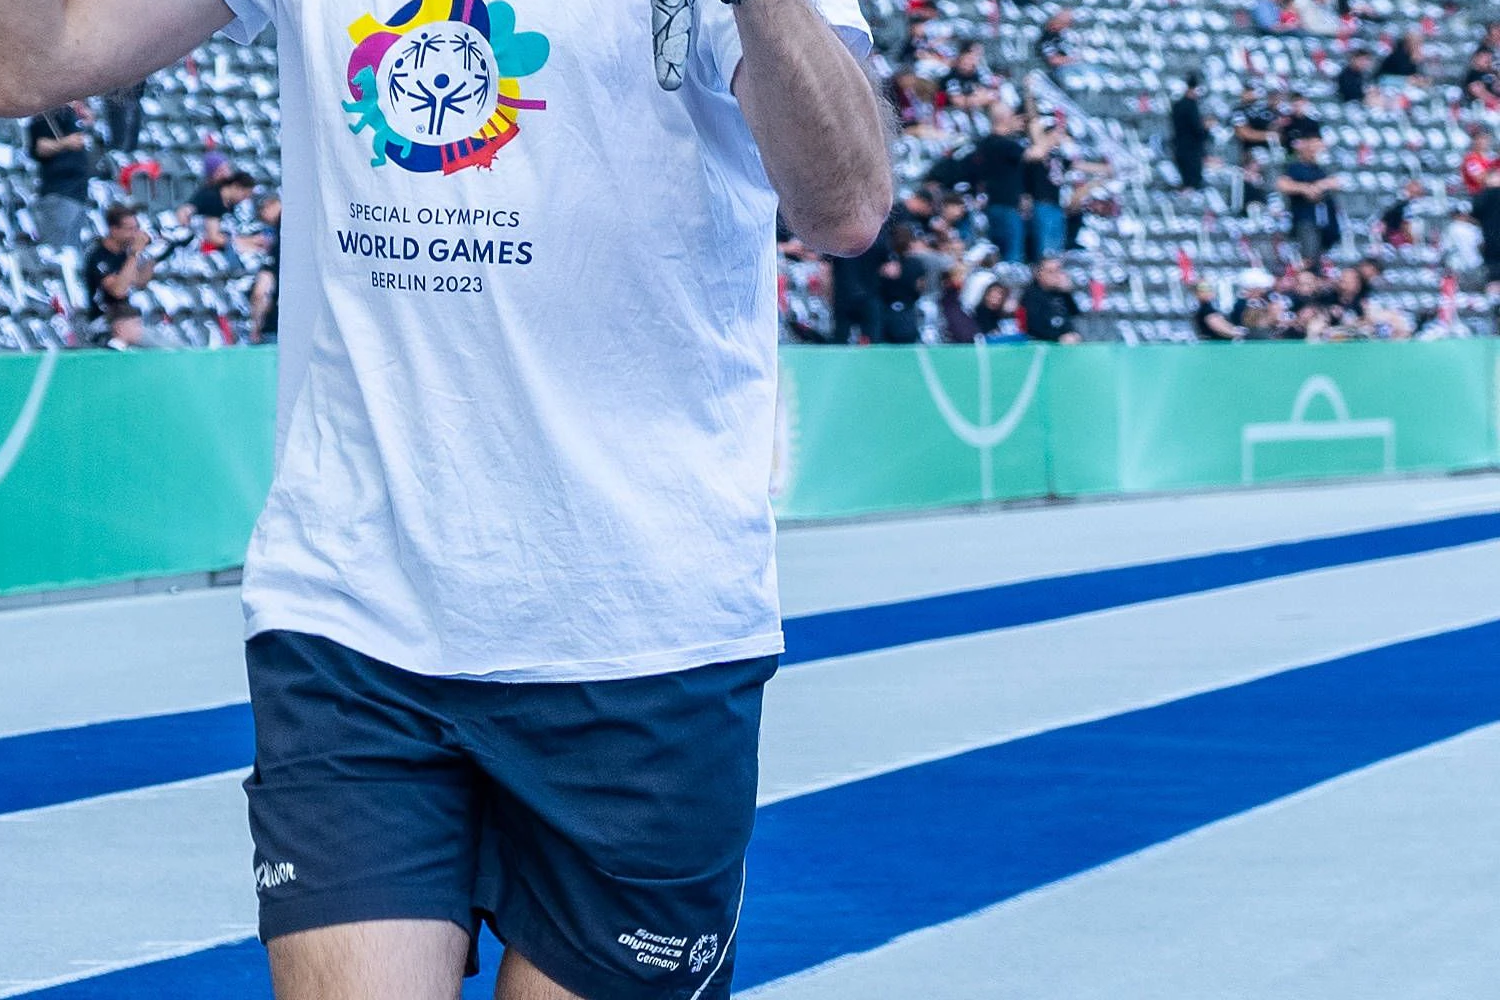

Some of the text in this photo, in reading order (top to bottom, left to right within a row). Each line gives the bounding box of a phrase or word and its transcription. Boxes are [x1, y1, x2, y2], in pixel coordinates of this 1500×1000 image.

[350, 202, 520, 228] SPECIAL OLYMPICS
[336, 230, 533, 265] WORLD GAMES
[371, 270, 483, 293] BERLIN 2023
[617, 933, 683, 958] Olympics
[634, 928, 688, 948] Special
[636, 952, 680, 972] Germany
